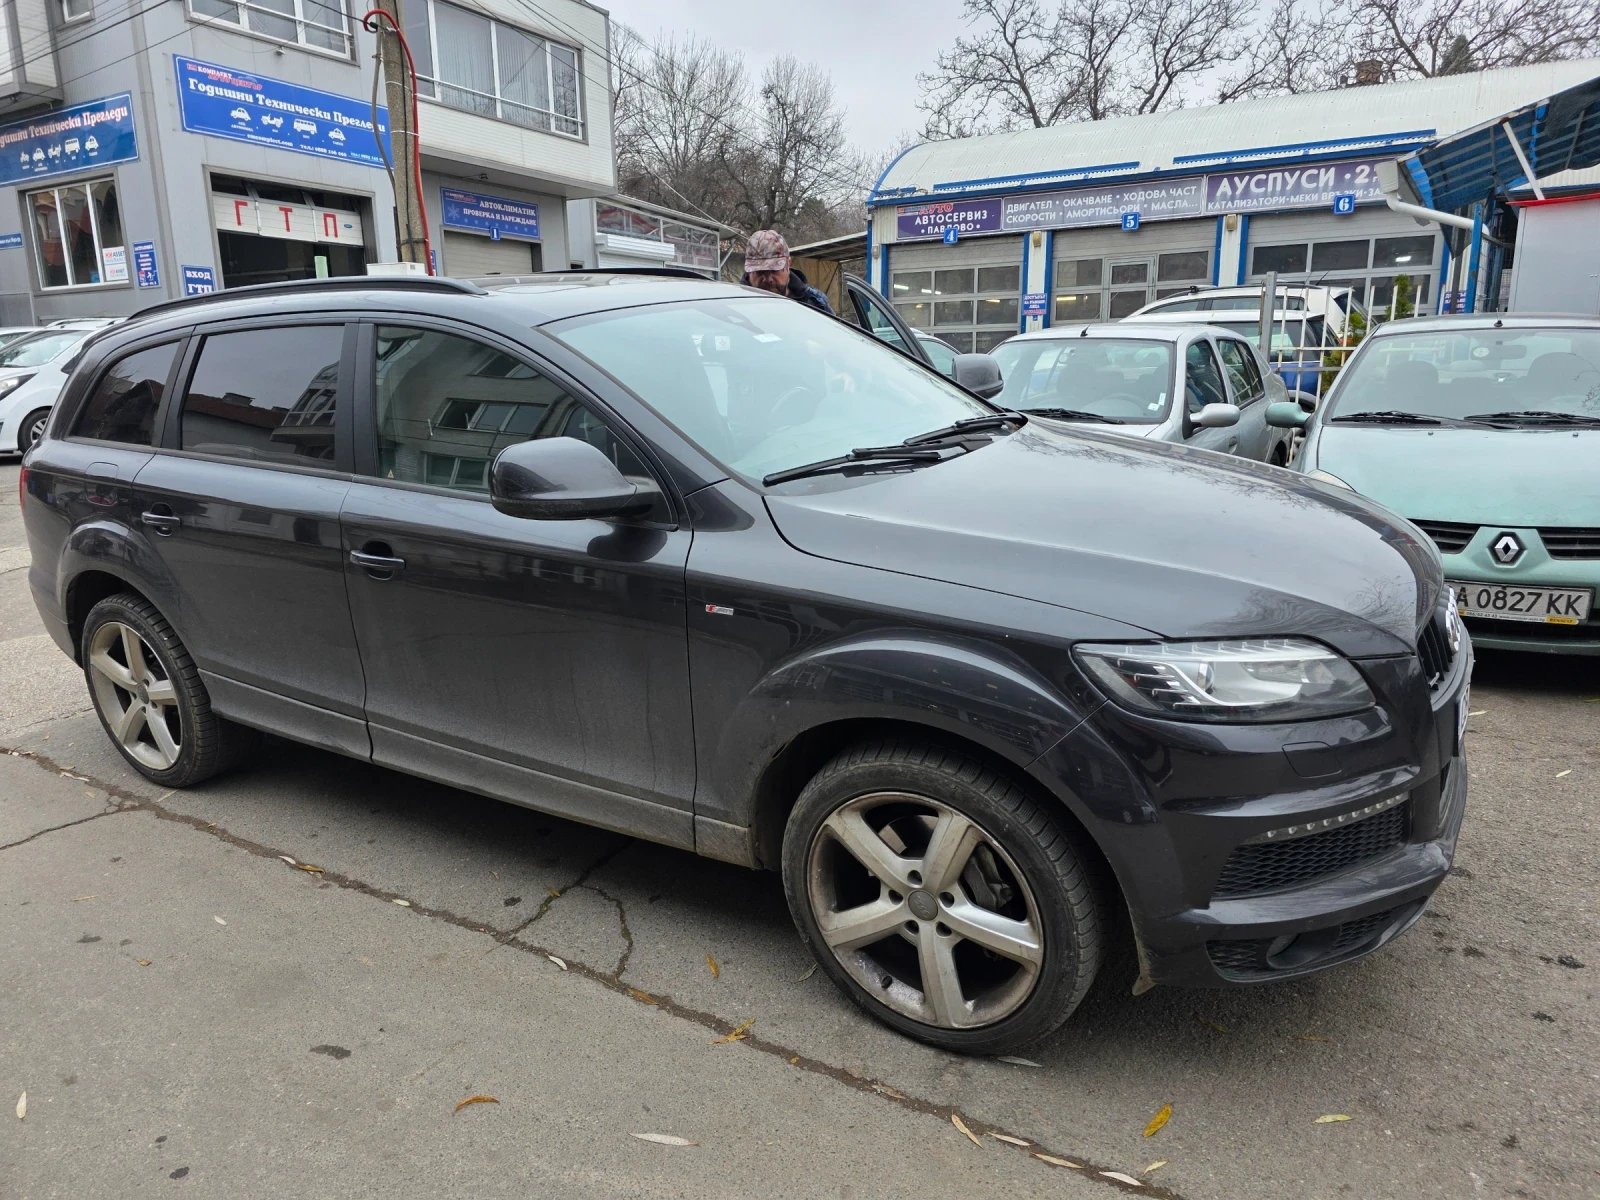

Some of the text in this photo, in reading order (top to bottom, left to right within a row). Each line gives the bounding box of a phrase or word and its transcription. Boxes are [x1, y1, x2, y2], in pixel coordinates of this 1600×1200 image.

[188, 77, 386, 133] Годишни Технически Преглеи
[29, 115, 82, 138] Технически
[82, 106, 128, 126] Прегледи
[1216, 166, 1336, 197] АУСПУСИ
[480, 200, 536, 216] АВТОКЛИМАТИК
[1006, 186, 1197, 214] ДВИГАТЕЛ ОКАЧВАНЕ ХОДОВА ЧАСТ
[1339, 198, 1349, 211] 6
[463, 208, 495, 220] ПРОВЕРКА
[501, 214, 537, 226] ЗАРЕЖДАНЕ
[914, 210, 988, 226] АВТОСЕРВИЗ
[1006, 211, 1056, 224] СКОРОСТИ
[1066, 203, 1140, 218] АМОРТИСЬОРИ
[1126, 215, 1135, 228] 5
[493, 228, 498, 238] 1
[947, 230, 954, 242] 4
[188, 283, 213, 294] ГТП
[1476, 589, 1543, 613] 0827
[1546, 593, 1583, 616] KK
